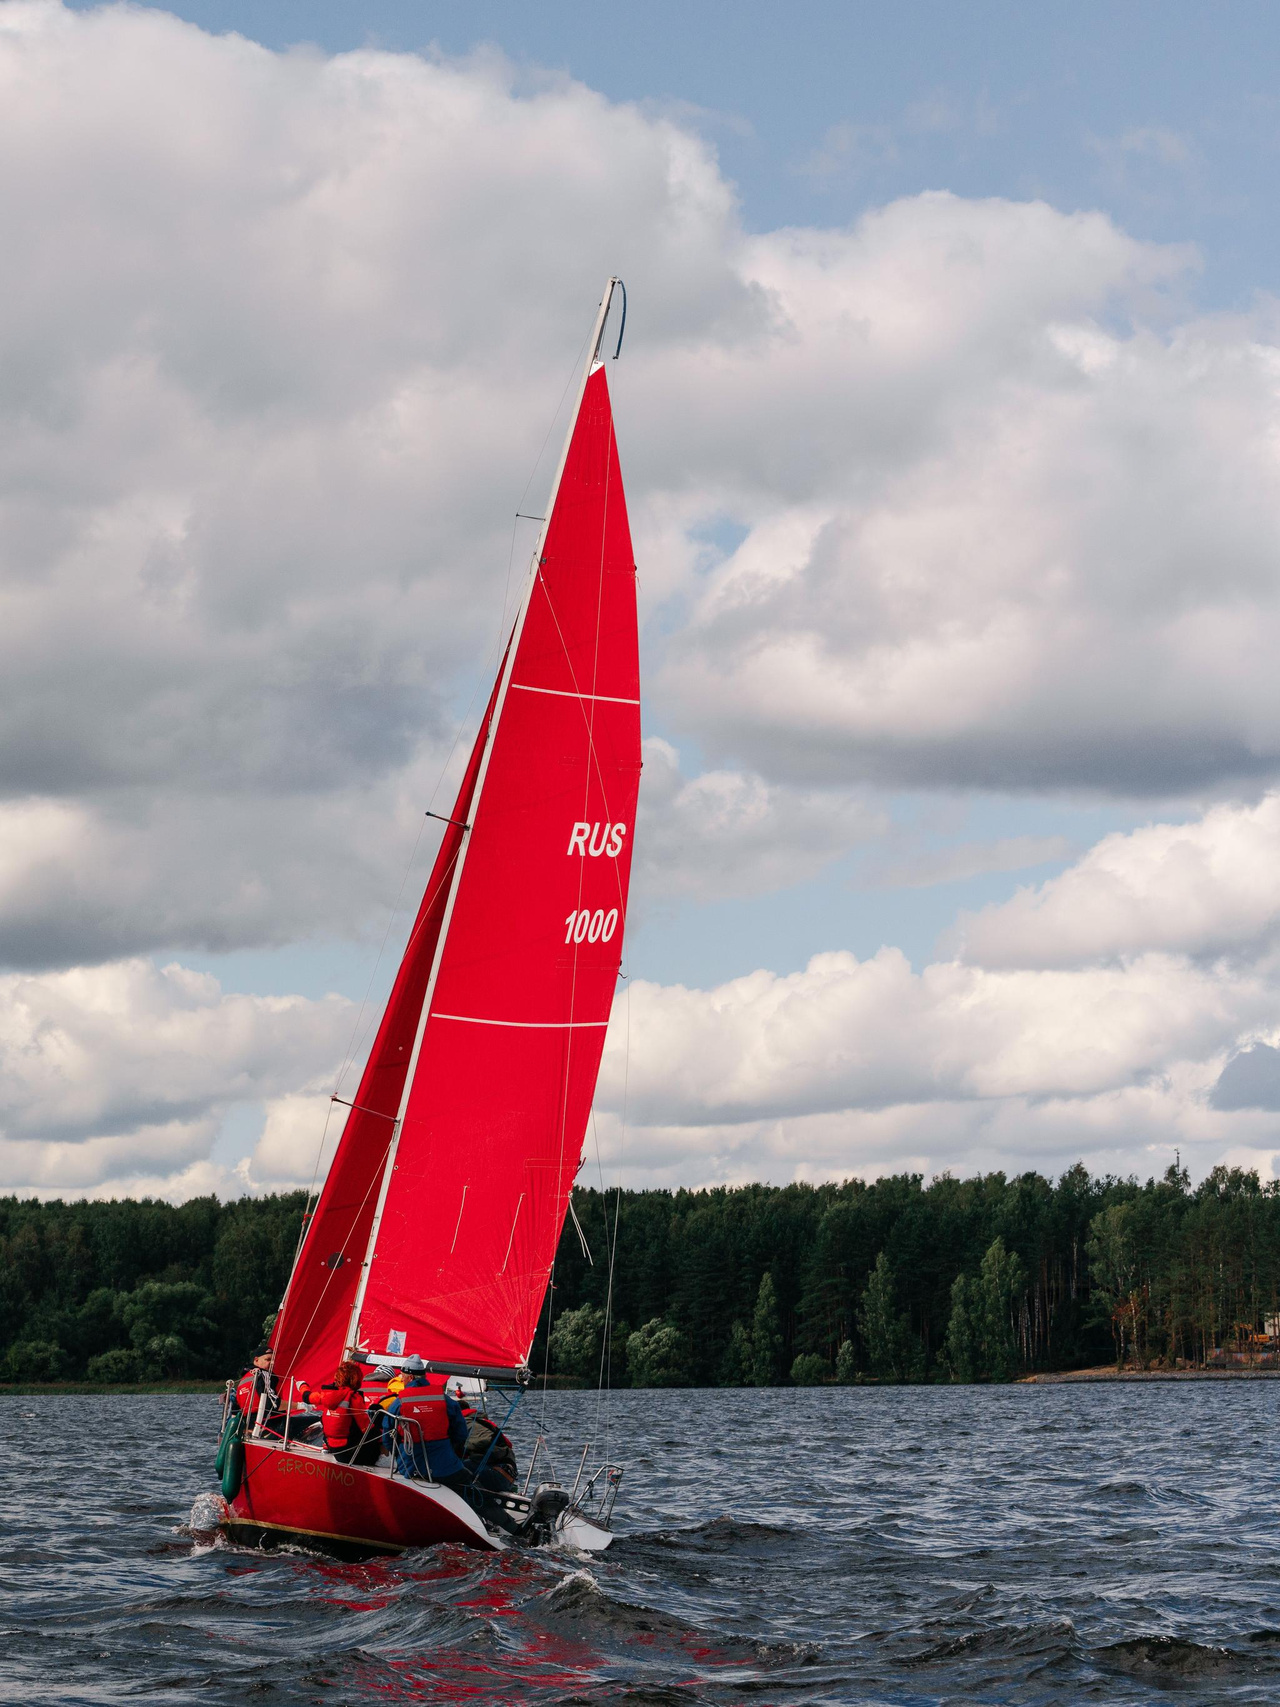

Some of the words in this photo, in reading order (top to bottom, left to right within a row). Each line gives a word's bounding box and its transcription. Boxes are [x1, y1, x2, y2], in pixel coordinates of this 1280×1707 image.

[567, 821, 627, 858] RUS
[564, 908, 619, 944] 1000
[277, 1458, 355, 1487] GERONIMO
